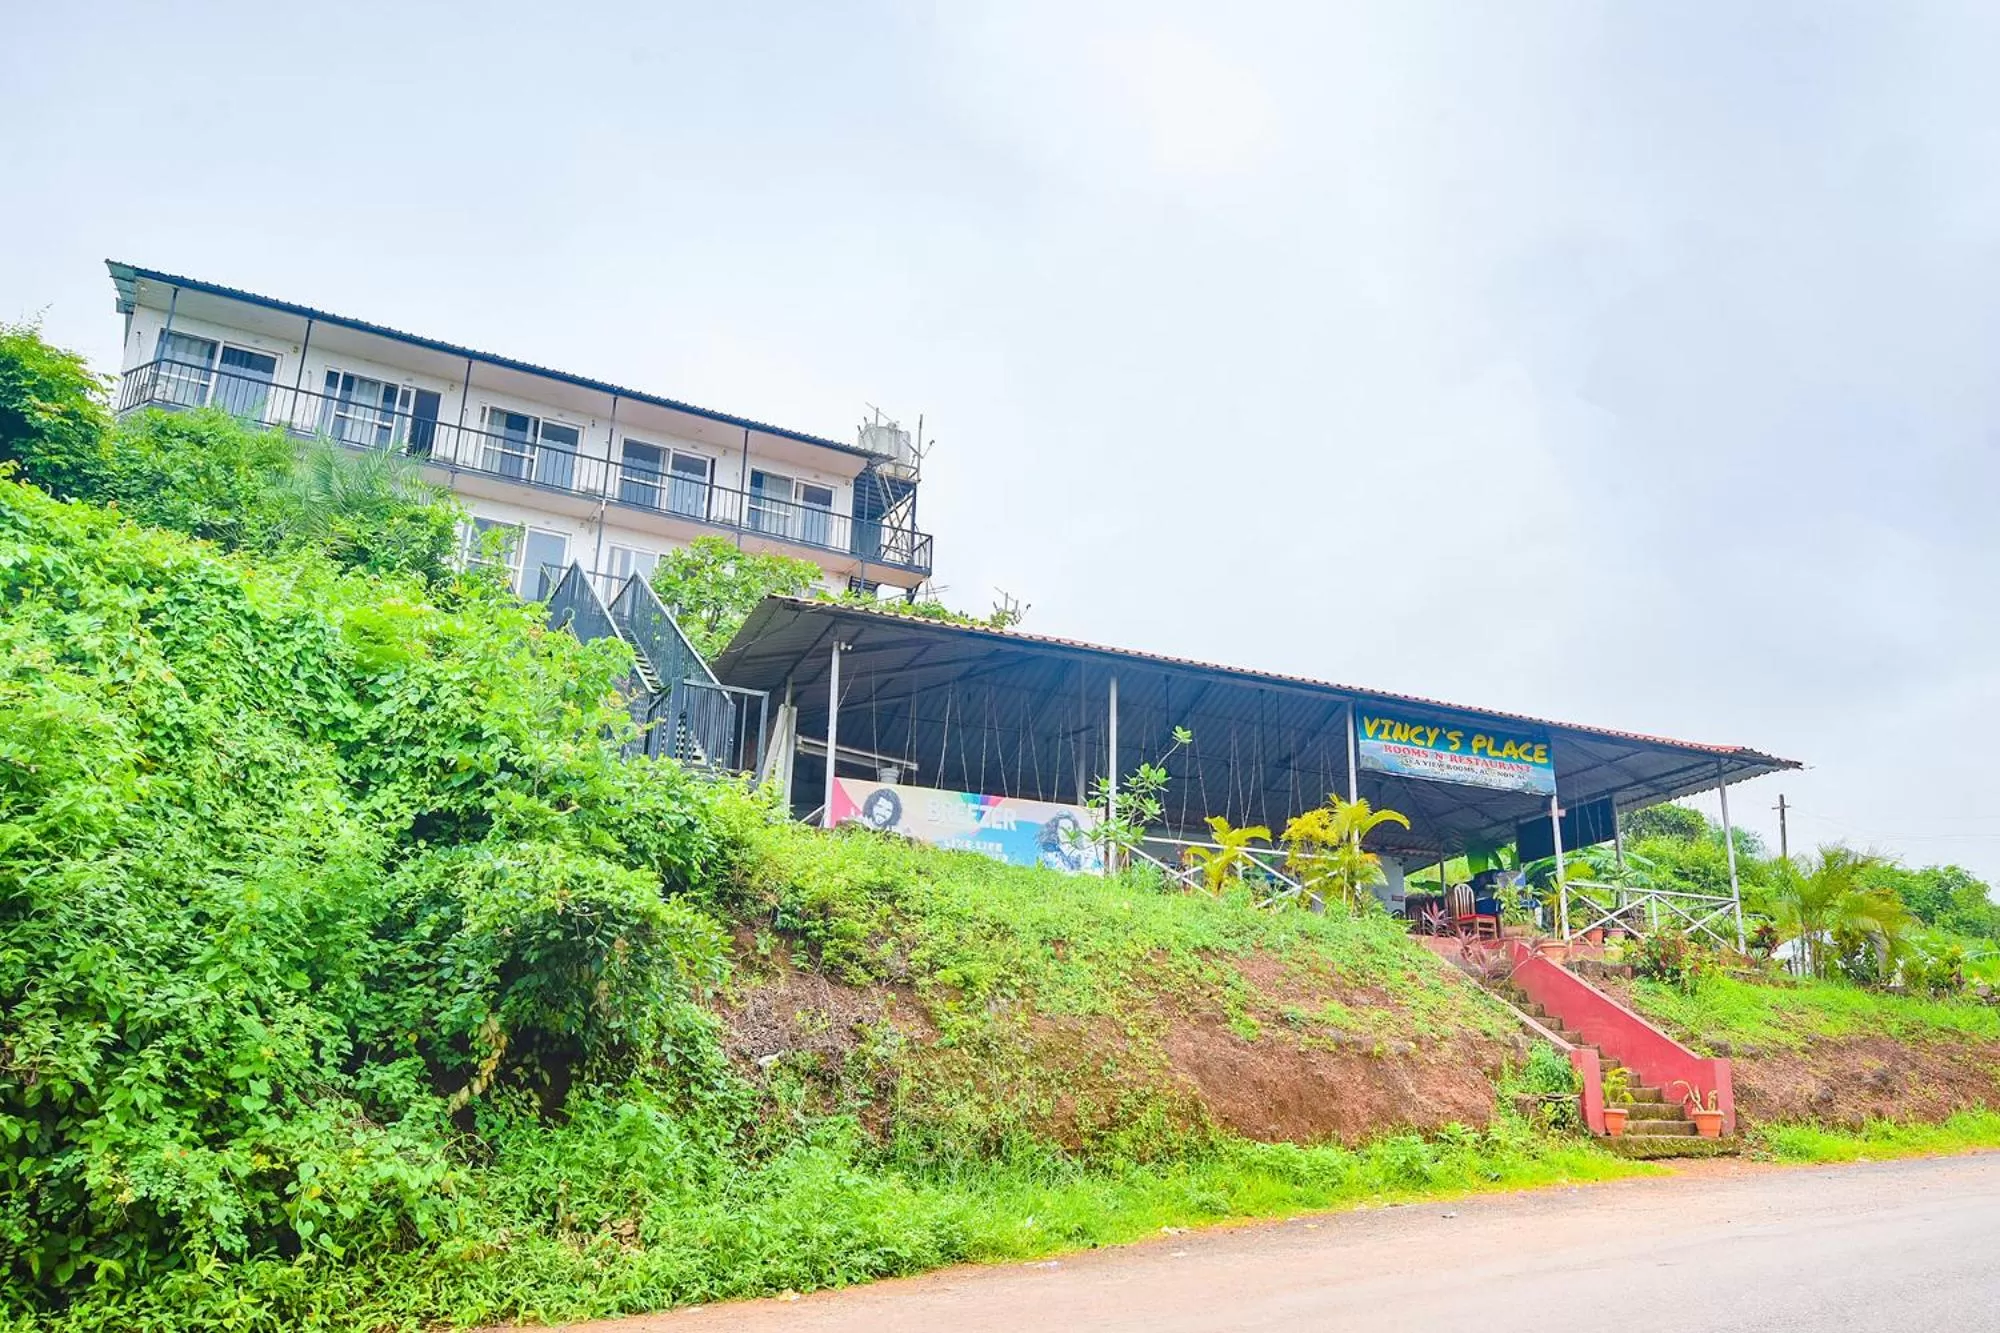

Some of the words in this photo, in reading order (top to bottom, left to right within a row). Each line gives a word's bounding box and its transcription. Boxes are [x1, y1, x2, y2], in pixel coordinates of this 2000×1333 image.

[1363, 715, 1464, 752] VINCY'S
[1472, 733, 1548, 764] PLACE
[1384, 744, 1429, 759] ROOMS
[1450, 753, 1532, 774] RESTAURANT
[927, 799, 1017, 832] BREEZER
